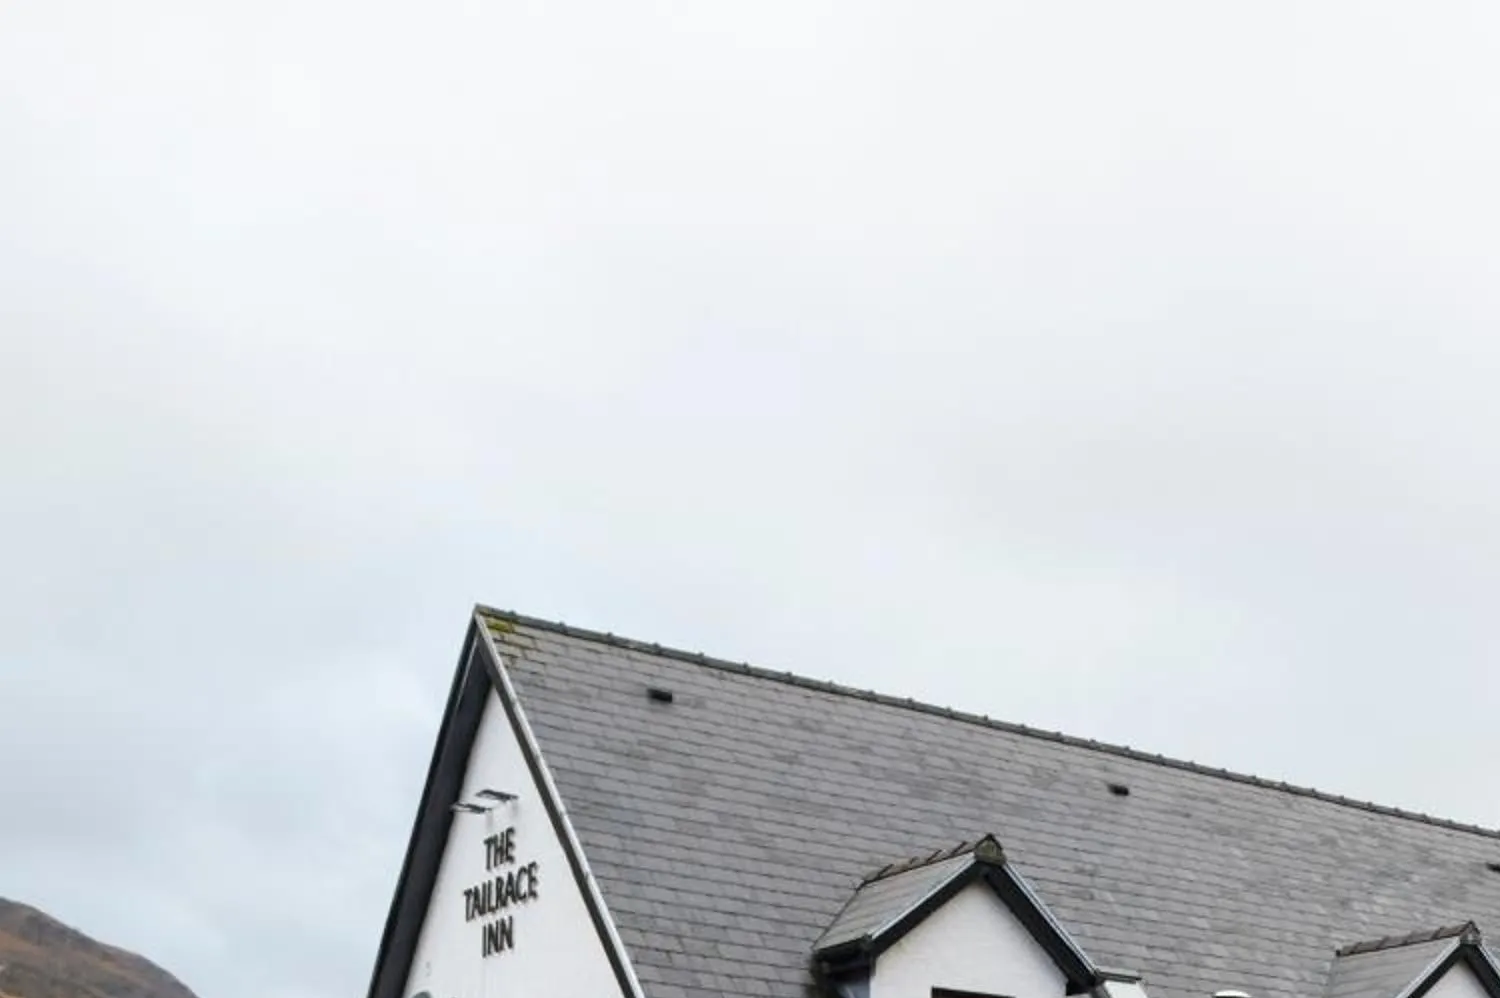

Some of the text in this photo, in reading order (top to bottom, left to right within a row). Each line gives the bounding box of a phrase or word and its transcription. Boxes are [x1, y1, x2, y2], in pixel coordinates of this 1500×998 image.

[484, 827, 516, 871] THE
[463, 861, 538, 922] TAILRACE
[481, 916, 514, 958] INN
